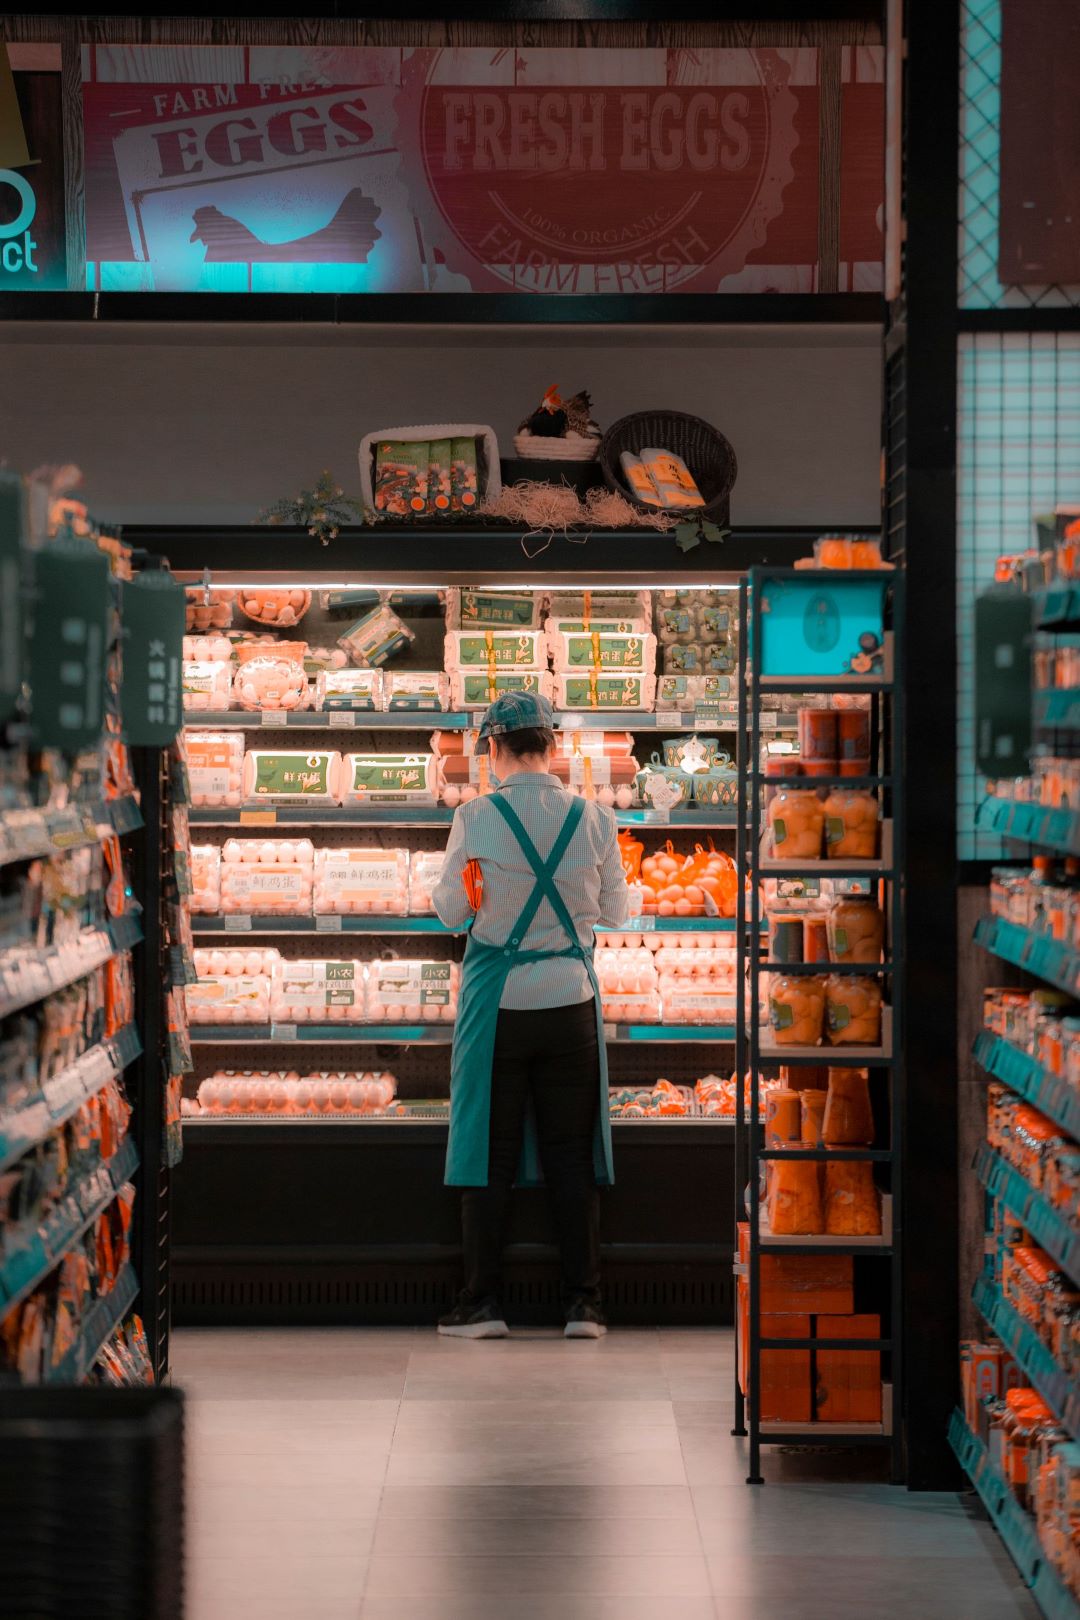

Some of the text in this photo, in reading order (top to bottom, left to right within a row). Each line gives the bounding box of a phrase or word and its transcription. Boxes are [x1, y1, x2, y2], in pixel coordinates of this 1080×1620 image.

[152, 83, 239, 117] FARM
[151, 98, 377, 179] EGGS
[442, 91, 750, 172] FRESH EGGS
[0, 231, 38, 273] ct
[521, 206, 672, 245] 100% ORGANIC
[477, 222, 710, 293] FARM FRESH
